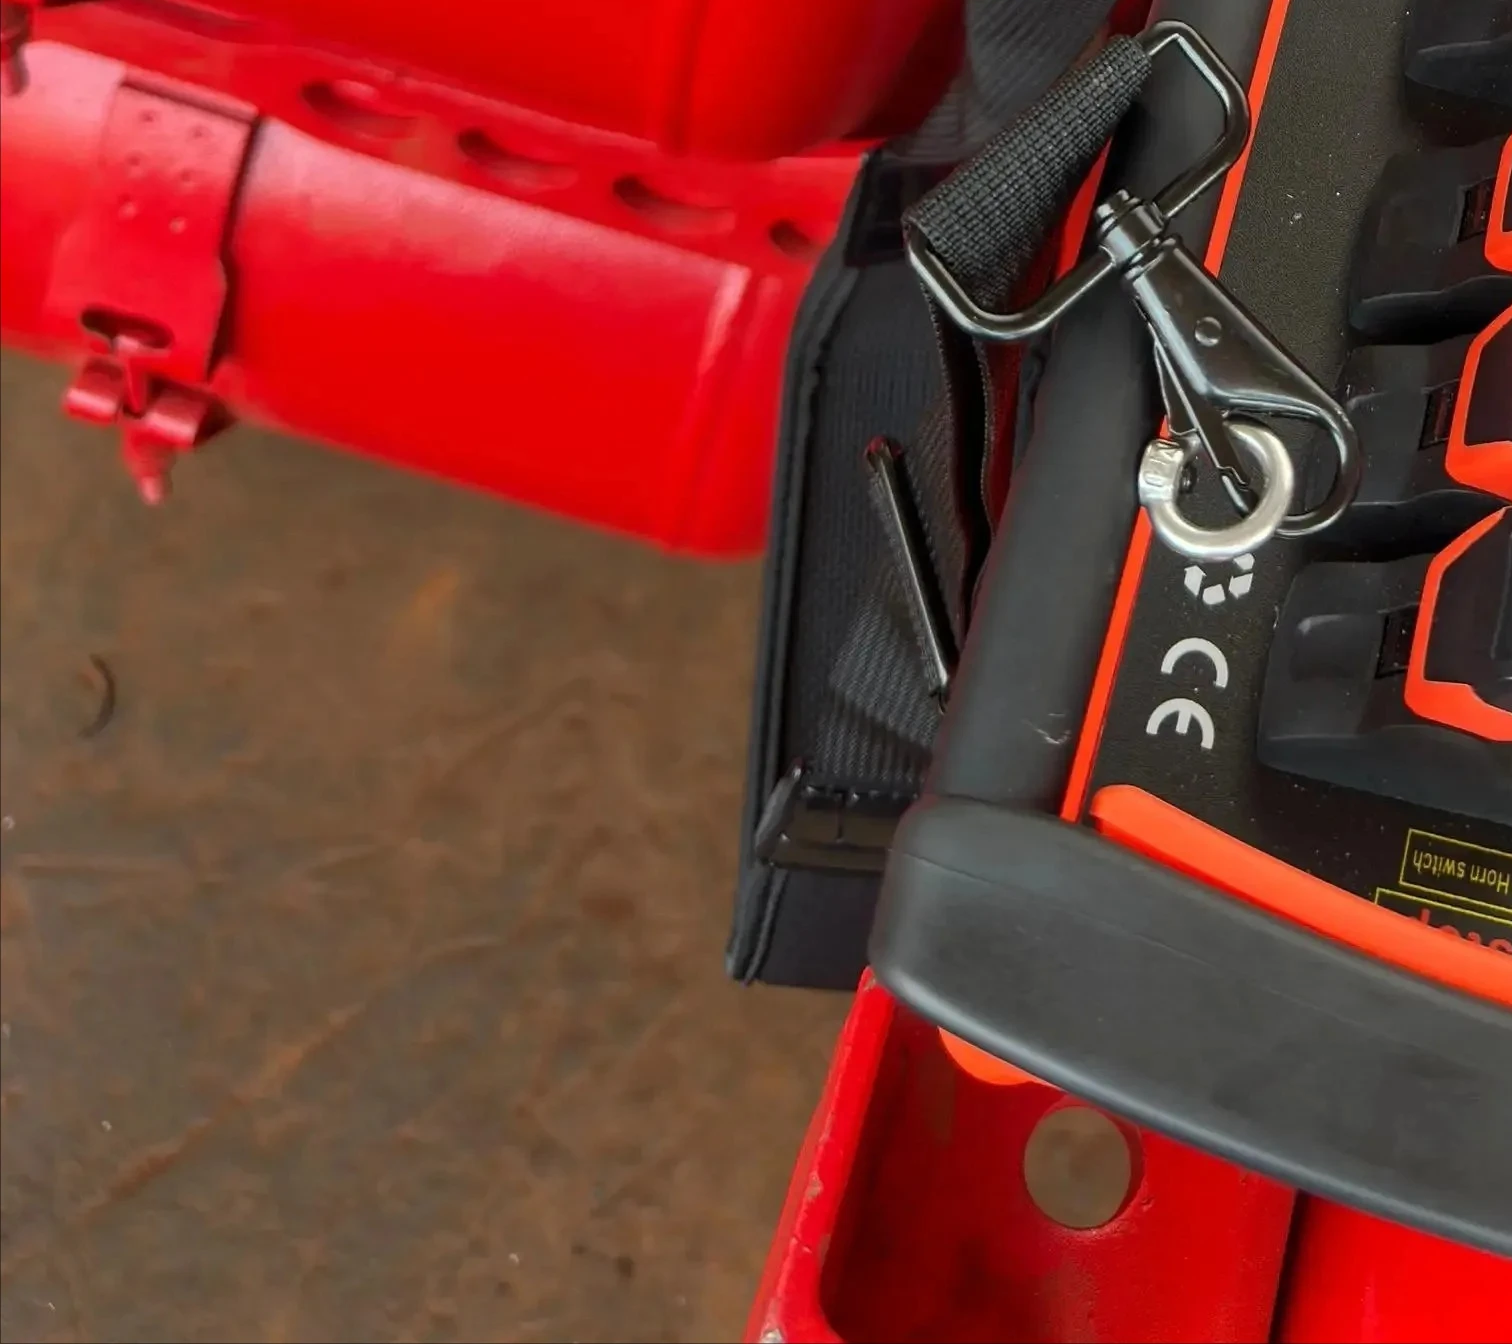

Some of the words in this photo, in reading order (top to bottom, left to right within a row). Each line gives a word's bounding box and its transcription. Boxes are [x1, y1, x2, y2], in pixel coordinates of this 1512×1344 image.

[1146, 637, 1229, 750] CE
[1412, 849, 1465, 879] switch
[1470, 866, 1510, 895] Horn
